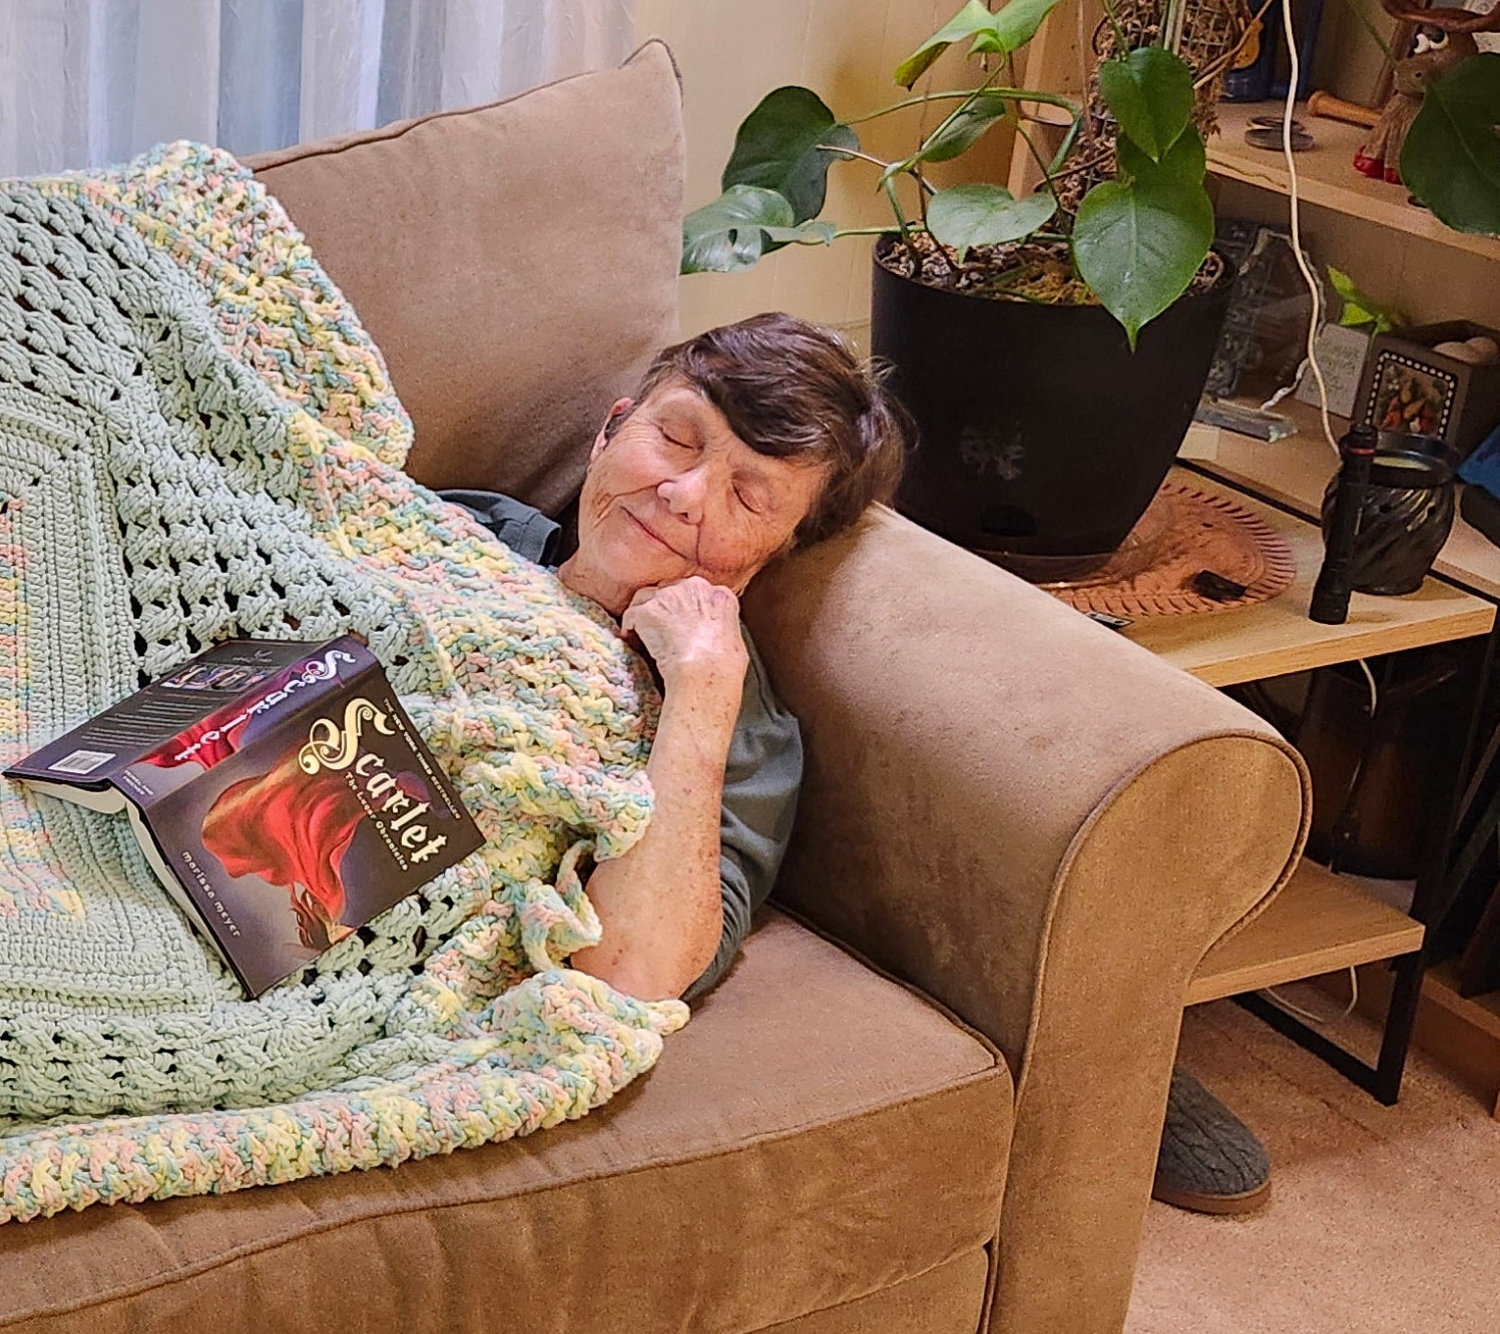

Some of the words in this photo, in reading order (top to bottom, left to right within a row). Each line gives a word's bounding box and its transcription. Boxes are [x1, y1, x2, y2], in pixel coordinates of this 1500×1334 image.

[174, 650, 356, 761] Scarlet
[383, 698, 395, 713] THE
[392, 714, 405, 731] NEW
[403, 732, 418, 752] YORK
[299, 698, 448, 863] Scarlet
[344, 772, 358, 791] The
